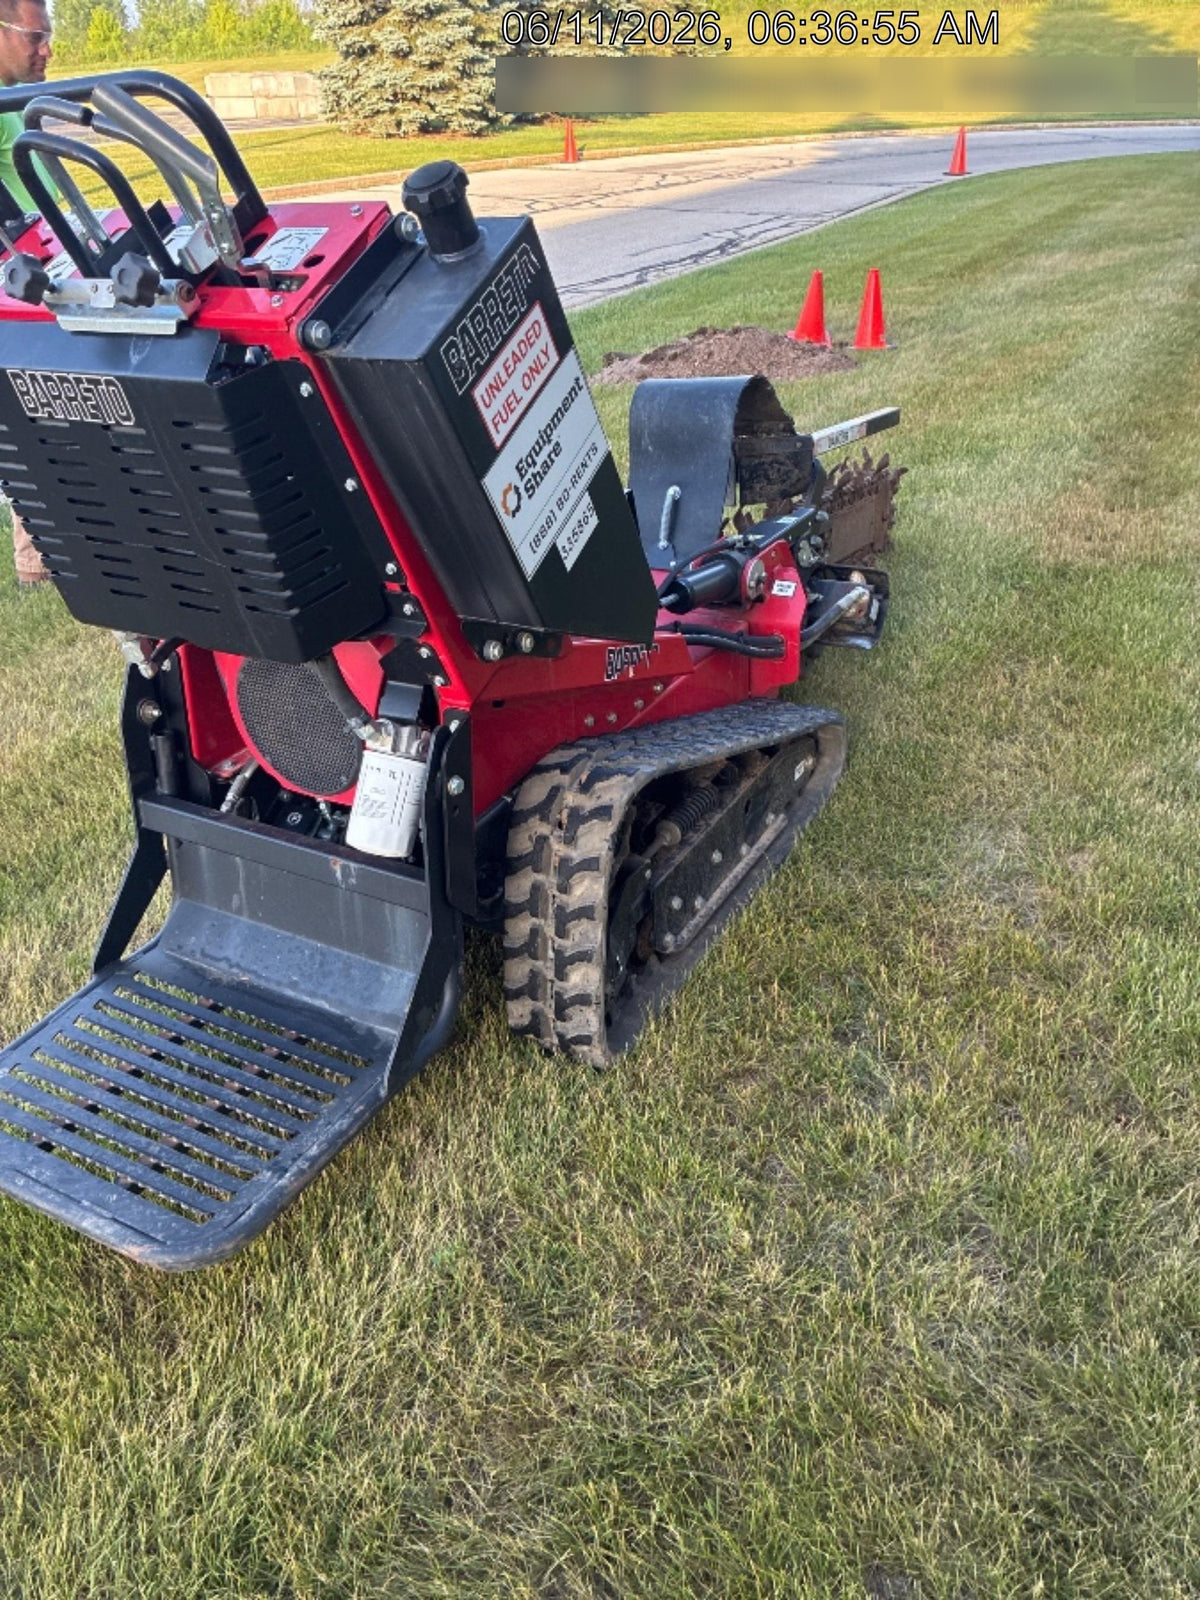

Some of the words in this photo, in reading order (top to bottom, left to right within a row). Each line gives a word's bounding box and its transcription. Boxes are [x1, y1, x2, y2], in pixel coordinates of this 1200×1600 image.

[6, 369, 136, 426] BARRETO
[480, 320, 542, 409] UNLEADED
[492, 389, 523, 434] FUEL
[522, 342, 550, 391] ONLY
[515, 376, 584, 482] Equipment
[524, 440, 563, 500] Share
